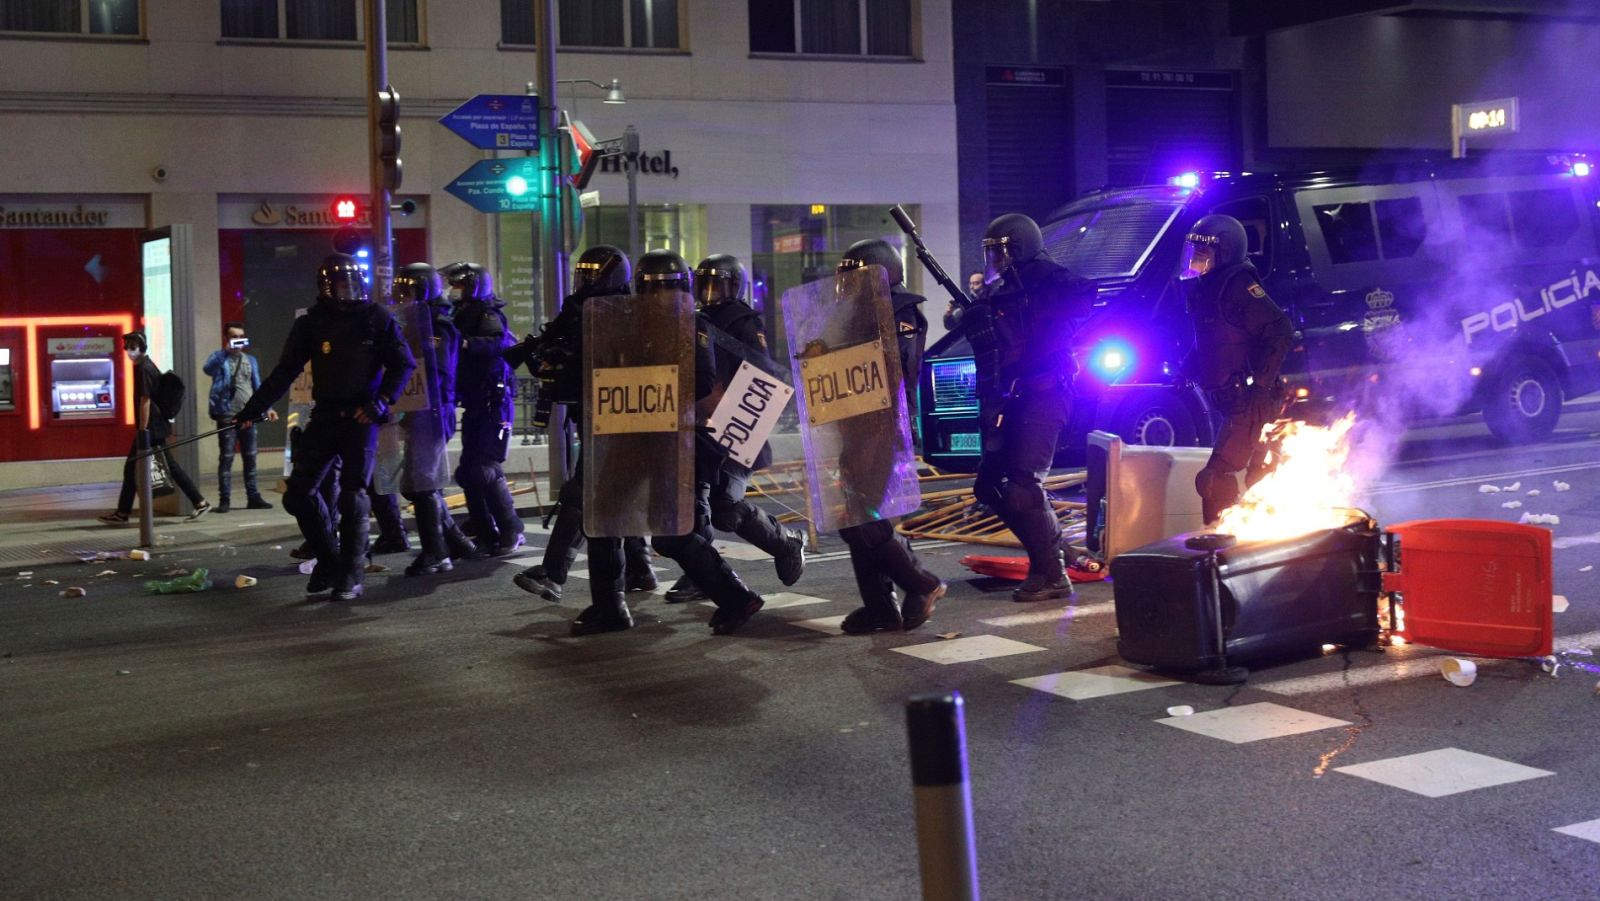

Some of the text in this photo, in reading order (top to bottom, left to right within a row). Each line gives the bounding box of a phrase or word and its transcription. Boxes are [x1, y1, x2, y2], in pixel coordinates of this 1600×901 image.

[470, 122, 489, 130] Plaza
[491, 122, 499, 130] de
[500, 198, 510, 208] 10
[1461, 268, 1600, 345] POLICÍA
[597, 383, 675, 415] POLICIA
[807, 360, 883, 407] POLICIA
[720, 376, 777, 457] POLICIA
